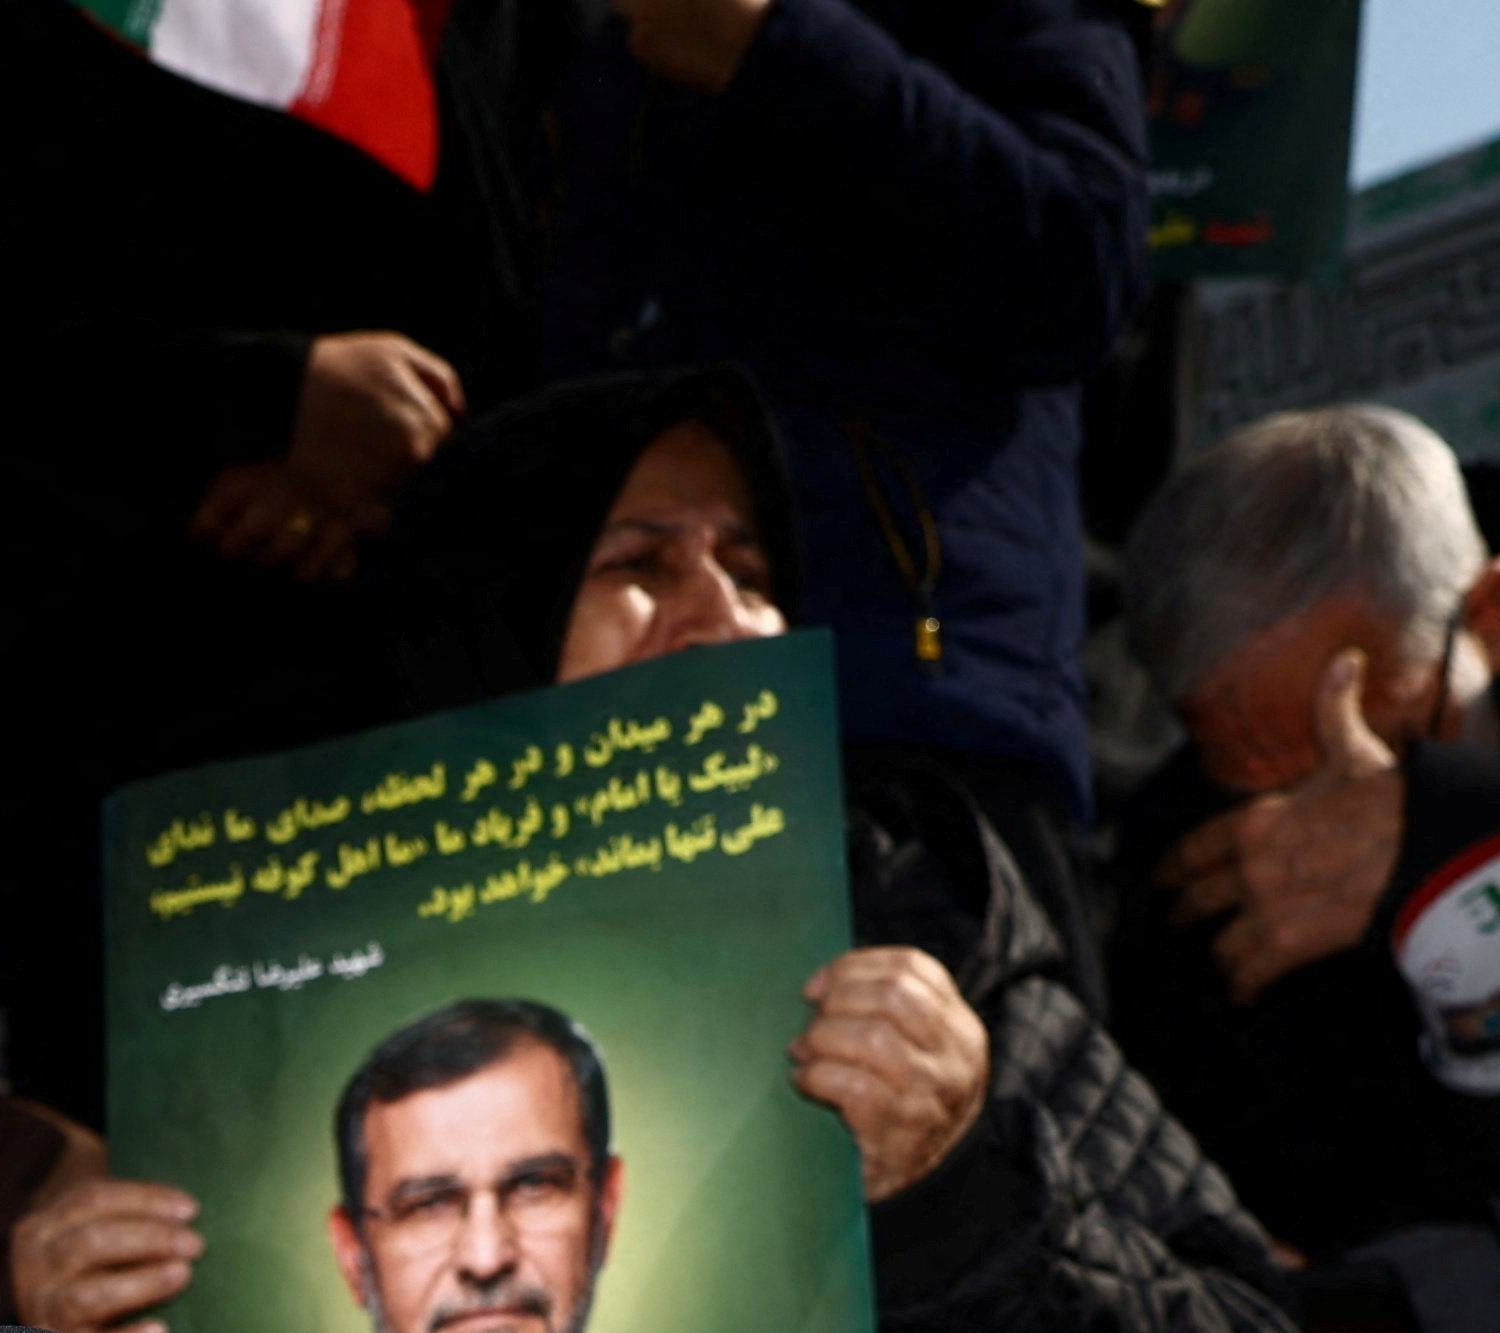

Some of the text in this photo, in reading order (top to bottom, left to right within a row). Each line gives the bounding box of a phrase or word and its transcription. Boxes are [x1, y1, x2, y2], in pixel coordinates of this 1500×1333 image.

[683, 701, 724, 745] هر
[737, 689, 778, 733] در
[461, 758, 496, 801] هر
[507, 744, 543, 790] در
[554, 742, 575, 777] و
[655, 764, 684, 806] یا
[223, 808, 255, 841] ما
[435, 819, 467, 855] ما
[551, 802, 571, 839] و
[720, 803, 784, 855] علی
[252, 849, 320, 899] کوفه
[325, 835, 381, 890] اهل
